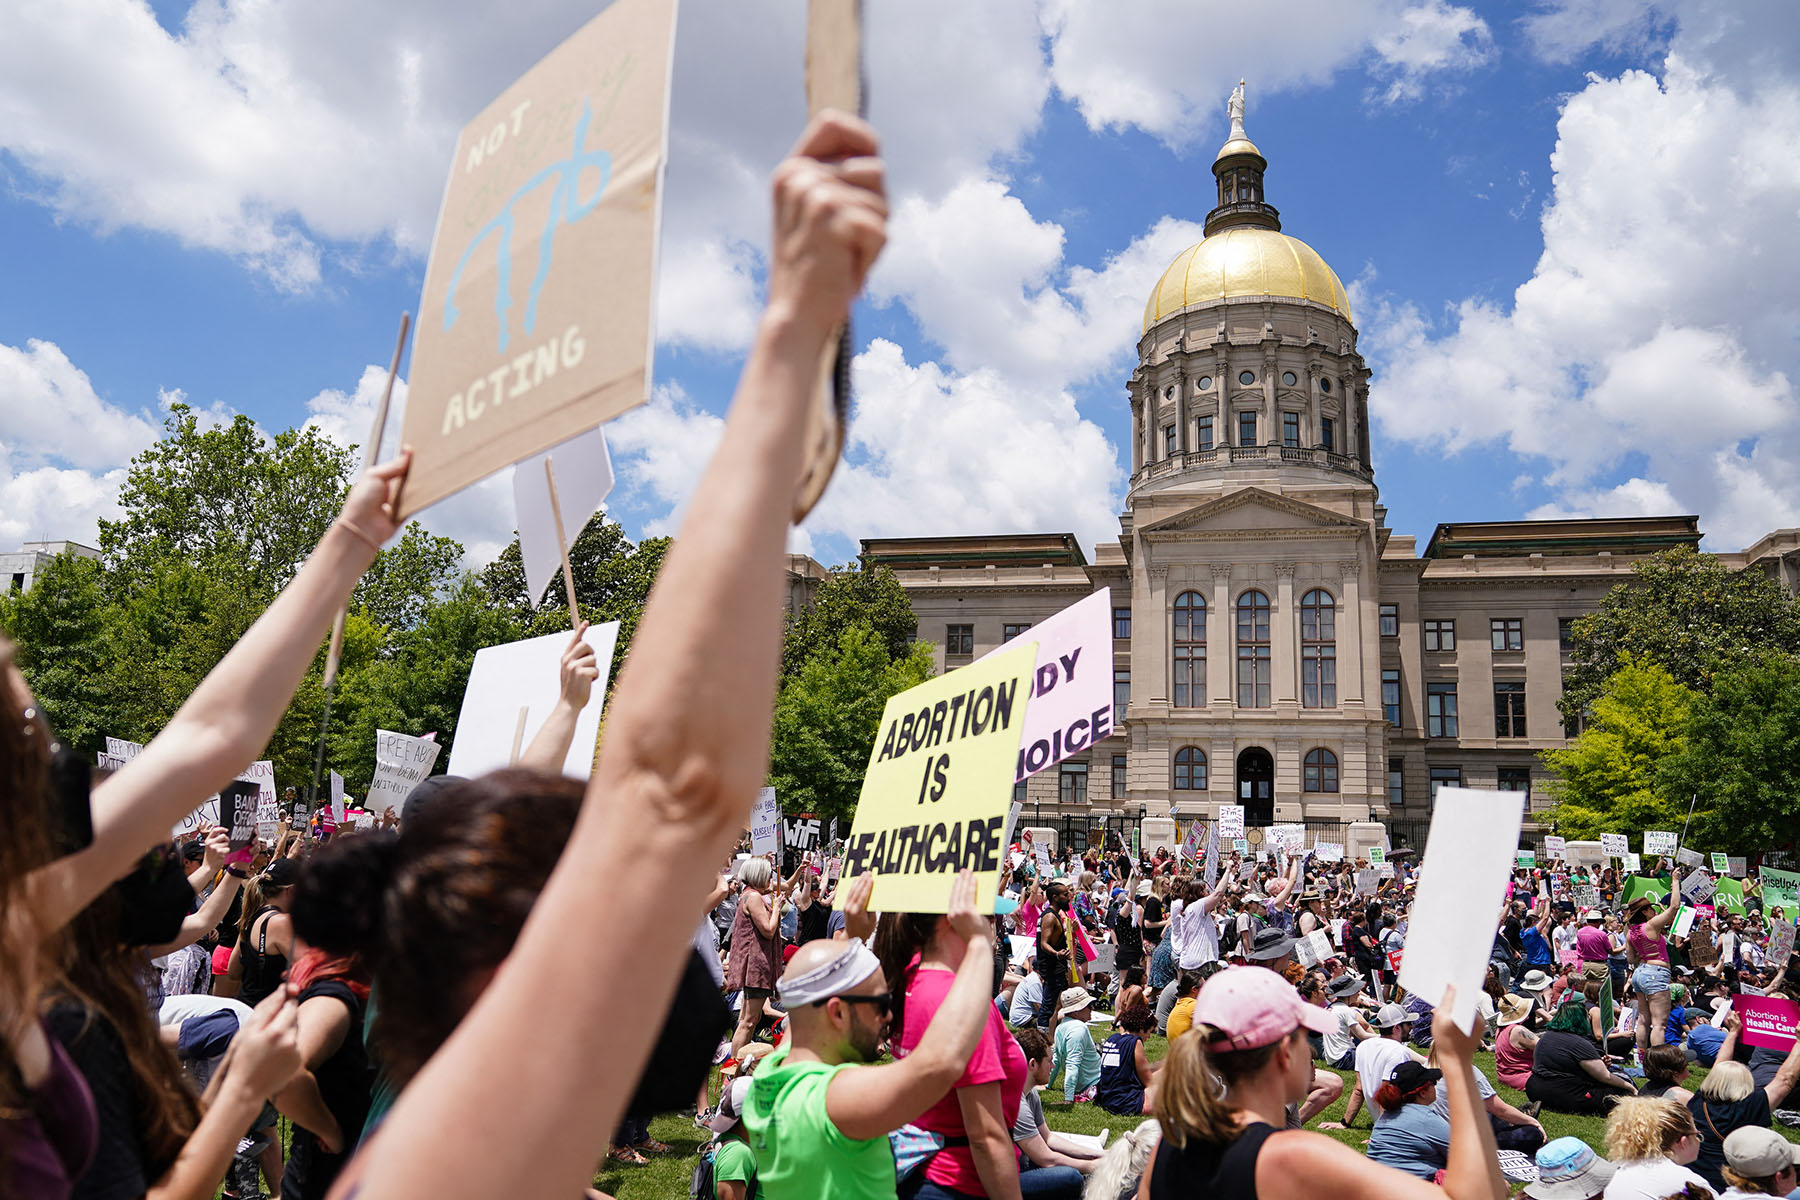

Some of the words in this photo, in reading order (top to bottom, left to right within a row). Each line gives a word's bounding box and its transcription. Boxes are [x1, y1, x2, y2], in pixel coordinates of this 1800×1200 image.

[465, 101, 532, 174] NOT
[441, 325, 587, 436] ACTING
[1029, 646, 1082, 700] DY
[877, 678, 1018, 763] ABORTION
[379, 733, 413, 761] FREE
[373, 778, 409, 796] WITHOUT
[918, 753, 950, 805] IS
[182, 797, 219, 829] DIRT
[234, 794, 257, 811] BANS
[783, 818, 821, 849] WTF
[842, 815, 1004, 879] HEALTHCARE
[1762, 874, 1800, 892] RiseUp4
[1745, 1008, 1779, 1021] Abortion
[1780, 1014, 1788, 1022] is
[1746, 1018, 1775, 1030] Health
[1775, 1022, 1796, 1033] Care
